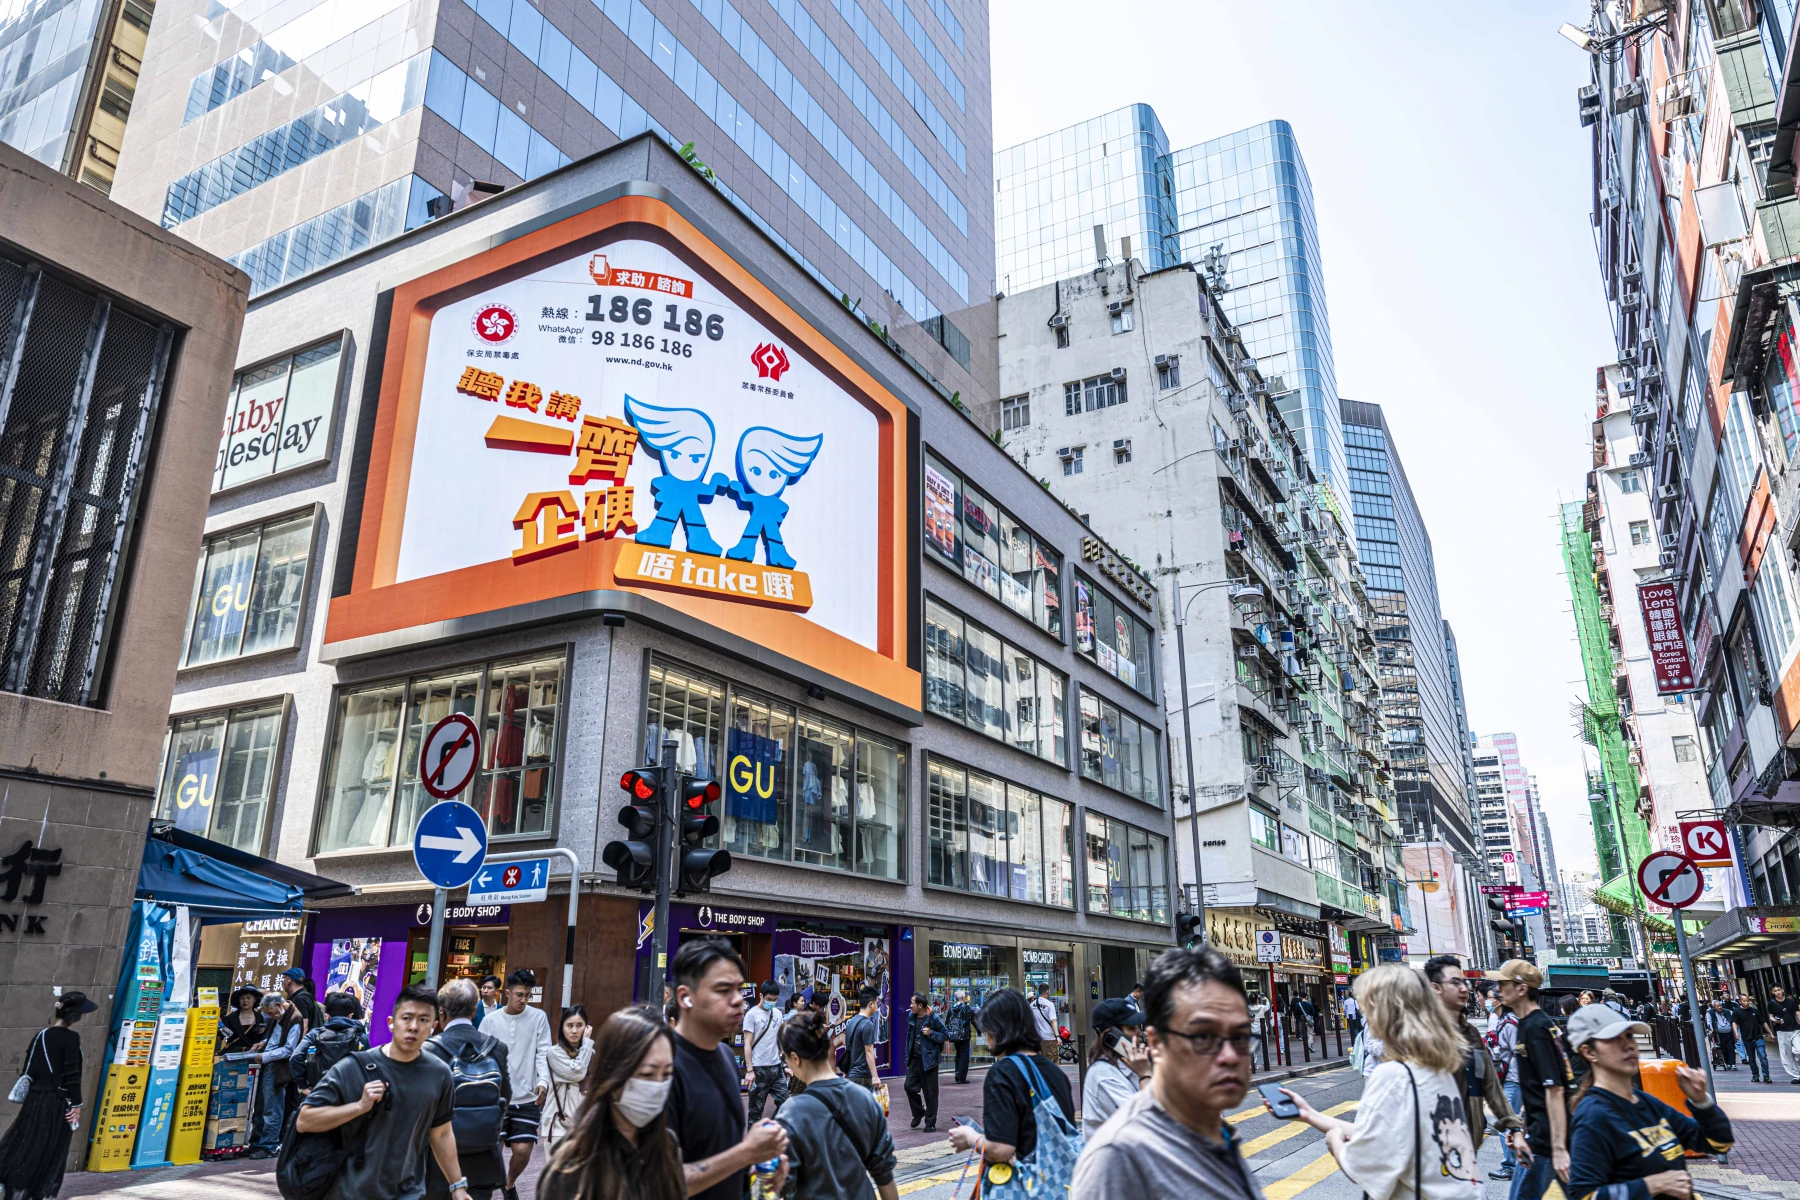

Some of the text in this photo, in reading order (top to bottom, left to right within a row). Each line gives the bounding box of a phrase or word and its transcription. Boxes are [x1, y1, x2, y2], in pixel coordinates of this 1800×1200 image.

[616, 270, 646, 287] 求助
[656, 276, 686, 295] 諮詢
[585, 294, 725, 341] 186 186
[538, 324, 585, 335] WhatsApp/
[591, 330, 693, 358] 98 186 186
[466, 349, 520, 360] 保安局禁毒處
[605, 356, 673, 371] www.nd.gov.hk
[456, 365, 582, 423] 聽我講
[741, 381, 795, 400] 禁毒常務委員會
[214, 415, 323, 473] uesday
[484, 414, 639, 487] 一齊
[926, 475, 936, 487] BUY
[941, 486, 950, 497] GET
[926, 483, 938, 496] FREE
[964, 494, 992, 533] Ruby
[512, 486, 638, 566] 企硬
[637, 551, 795, 600] 唔 take 嘢
[211, 582, 250, 617] GU
[1642, 588, 1673, 600] Love
[1644, 598, 1675, 609] Lens
[1648, 607, 1675, 620] 韓國
[1651, 619, 1677, 631] 隱形
[1653, 629, 1679, 641] 眼鏡
[1652, 640, 1683, 651] 專門店
[1656, 656, 1686, 665] Contact
[729, 755, 775, 799] GU
[176, 773, 213, 810] GU
[1202, 838, 1226, 847] sense
[1696, 831, 1721, 853] K
[0, 840, 62, 903] 行
[480, 893, 499, 901] 旺角站
[453, 907, 476, 918] BODY
[477, 905, 501, 916] SHOP
[245, 918, 299, 932] CHANGE
[714, 913, 765, 926] THE BODY SHOP
[455, 938, 470, 950] FACE
[801, 938, 830, 953] BOLD THEN.
[943, 945, 982, 959] BOMB CATCH
[1023, 950, 1054, 964] BOMB CATCH
[817, 963, 829, 983] IT'S
[121, 1092, 137, 1102] 6倍
